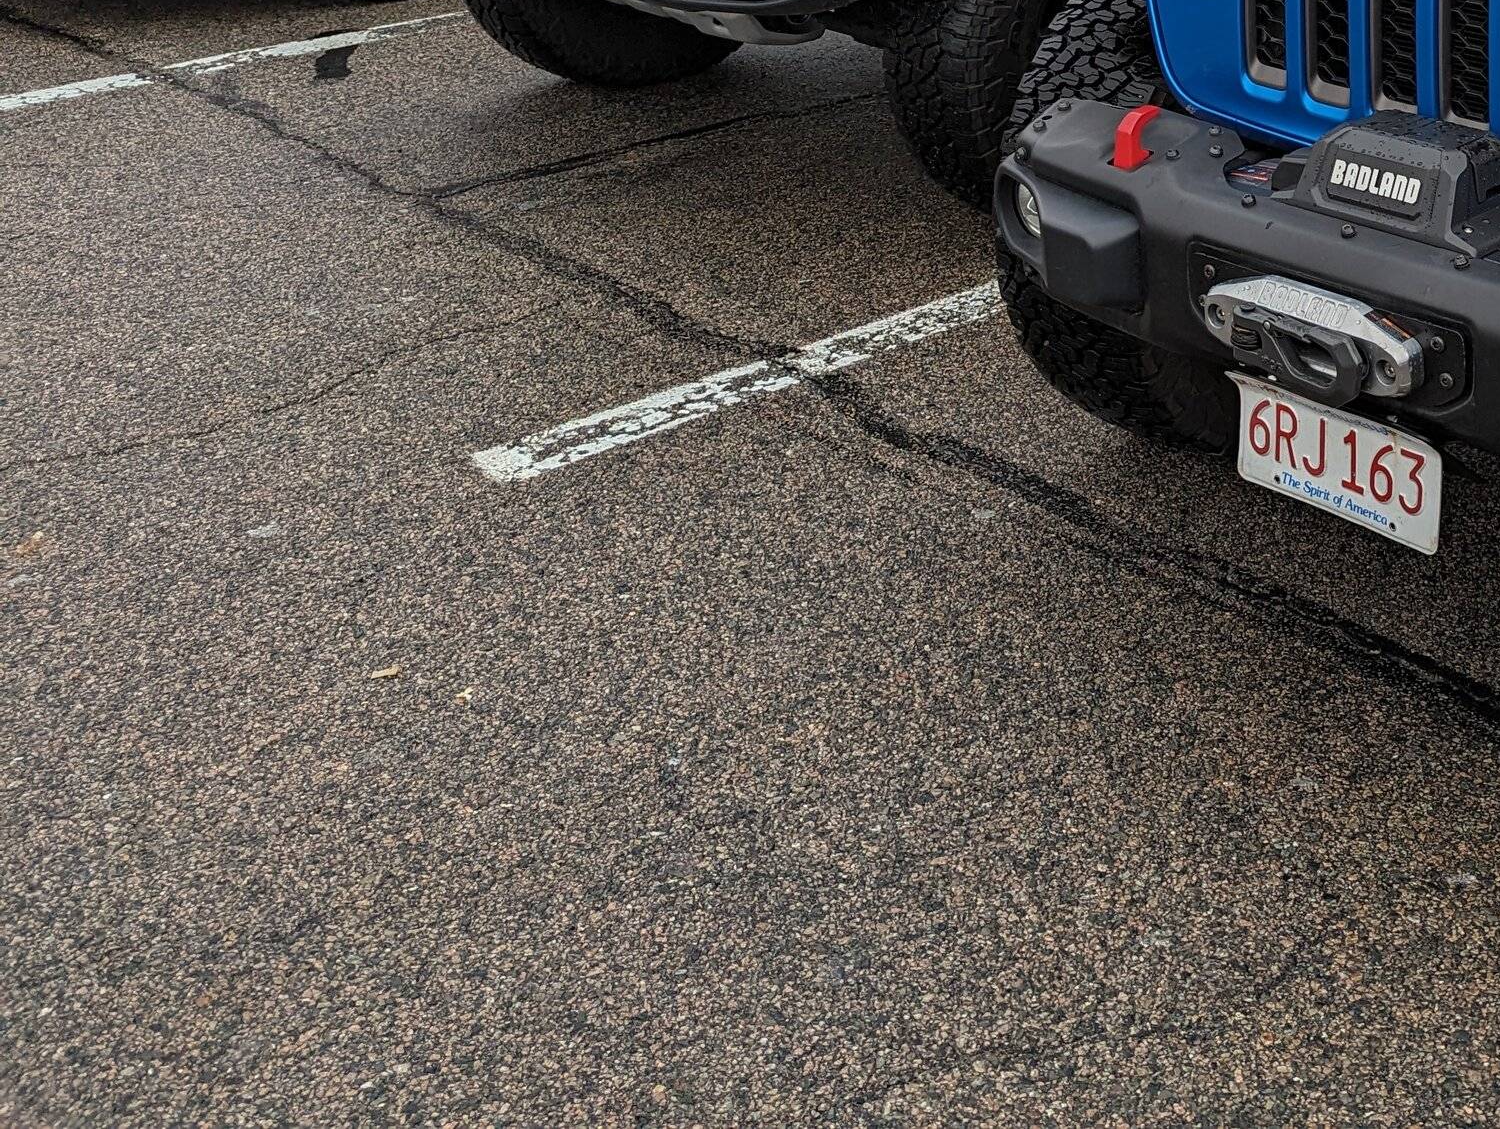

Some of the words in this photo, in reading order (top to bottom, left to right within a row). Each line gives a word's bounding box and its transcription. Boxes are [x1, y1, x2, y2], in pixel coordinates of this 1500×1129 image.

[1330, 158, 1422, 205] BADLAND
[1257, 281, 1349, 328] BADLAND
[1249, 399, 1328, 477] 6RJ
[1341, 429, 1426, 515] 163
[1282, 471, 1300, 489] The
[1303, 480, 1331, 501] Spirit
[1333, 494, 1344, 508] of
[1345, 498, 1388, 526] America
